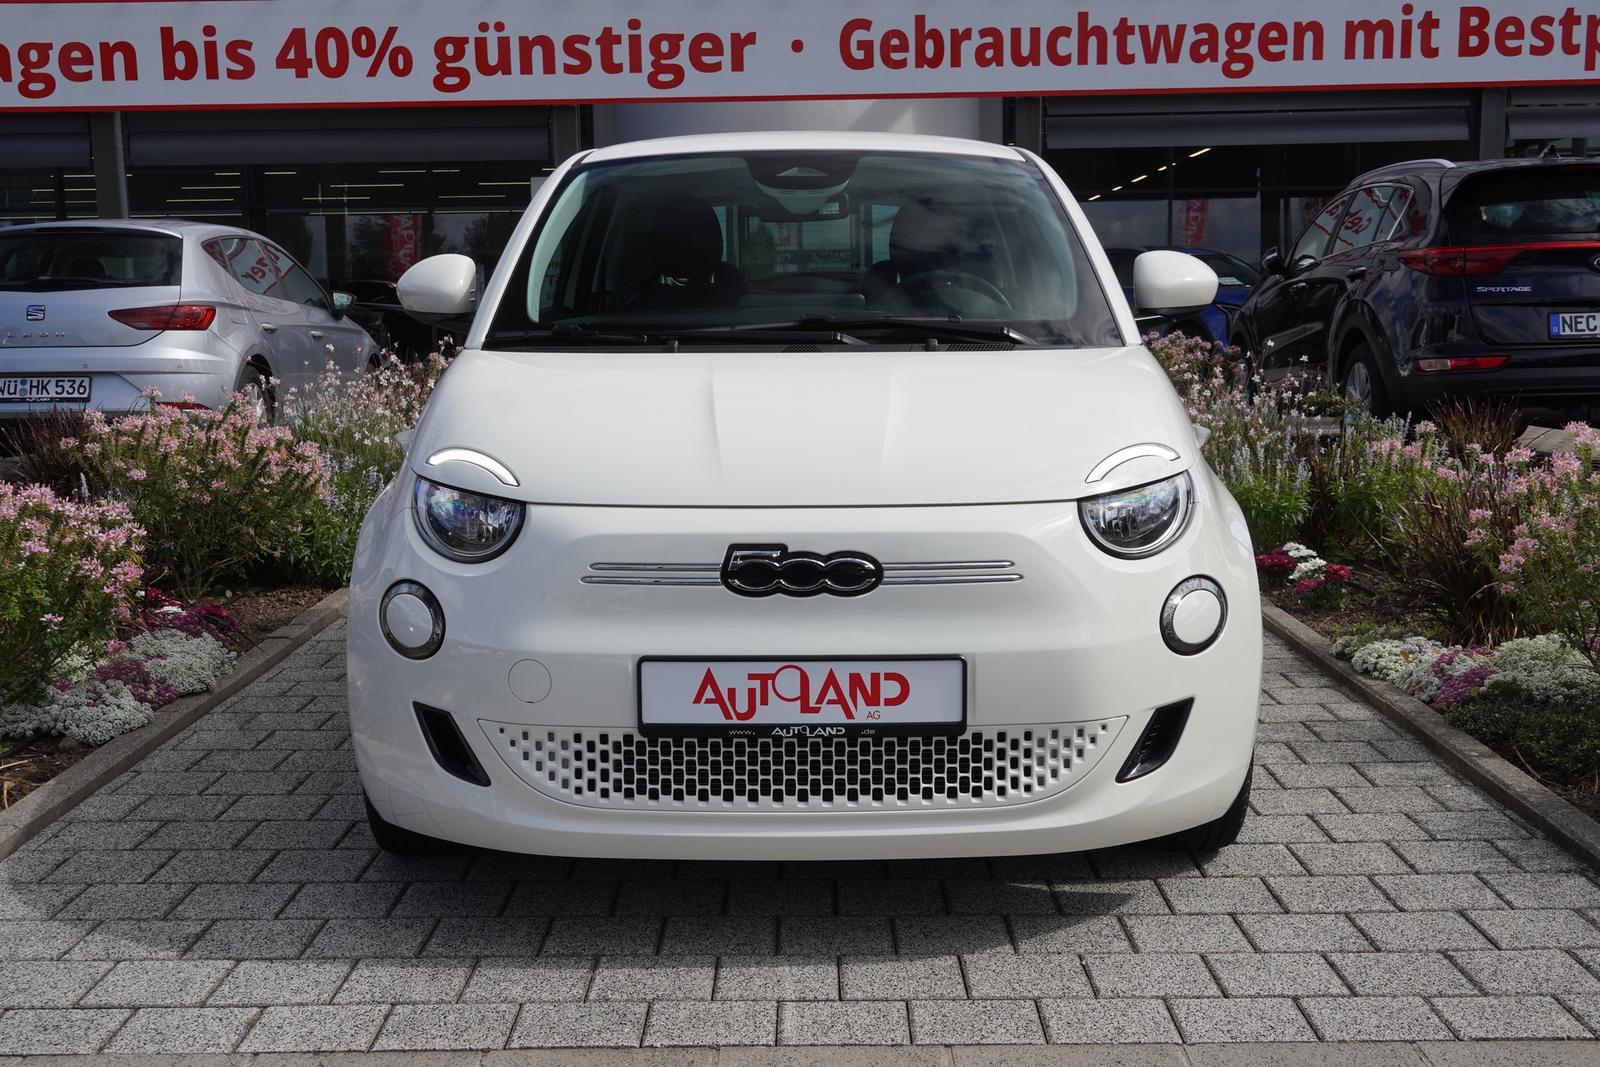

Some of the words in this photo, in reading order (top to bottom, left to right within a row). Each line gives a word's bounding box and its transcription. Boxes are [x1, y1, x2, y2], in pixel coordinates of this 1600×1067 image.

[160, 26, 256, 81] bis
[275, 27, 413, 79] 40%
[432, 19, 757, 93] günstiger
[839, 12, 1324, 79] Gebrauchtwagen
[1344, 4, 1440, 60] mit
[1561, 315, 1598, 333] NEC
[29, 379, 52, 396] HK
[55, 379, 87, 396] 536
[723, 545, 881, 595] 500
[693, 665, 911, 721] AUTOLAND
[866, 711, 882, 720] AG
[771, 725, 846, 738] AUTOLAND
